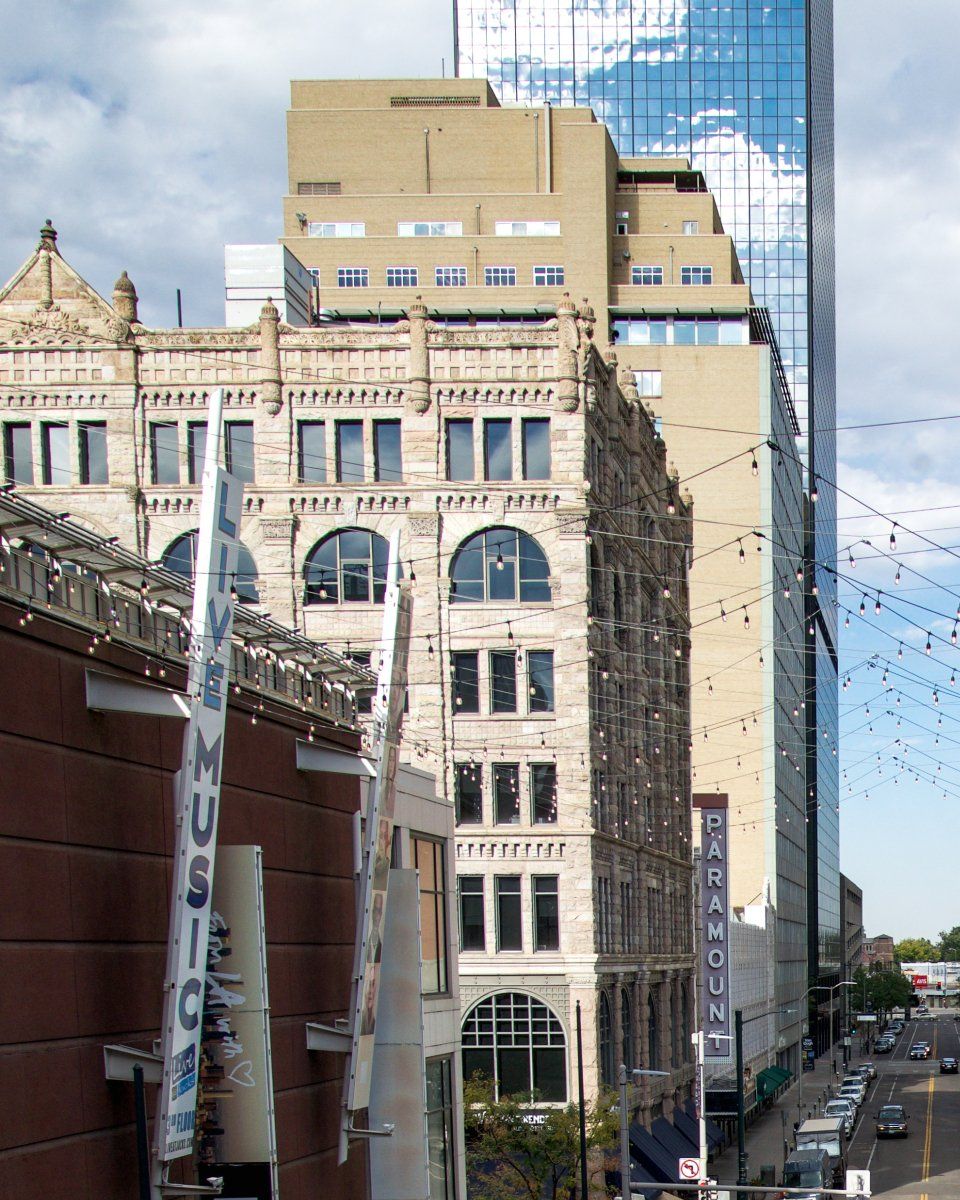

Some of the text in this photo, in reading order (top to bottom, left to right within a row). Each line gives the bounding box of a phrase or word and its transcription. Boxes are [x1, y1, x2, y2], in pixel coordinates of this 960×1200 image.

[178, 481, 236, 1032] LIVE MUSIC
[707, 814, 725, 1049] PARAMOUNT
